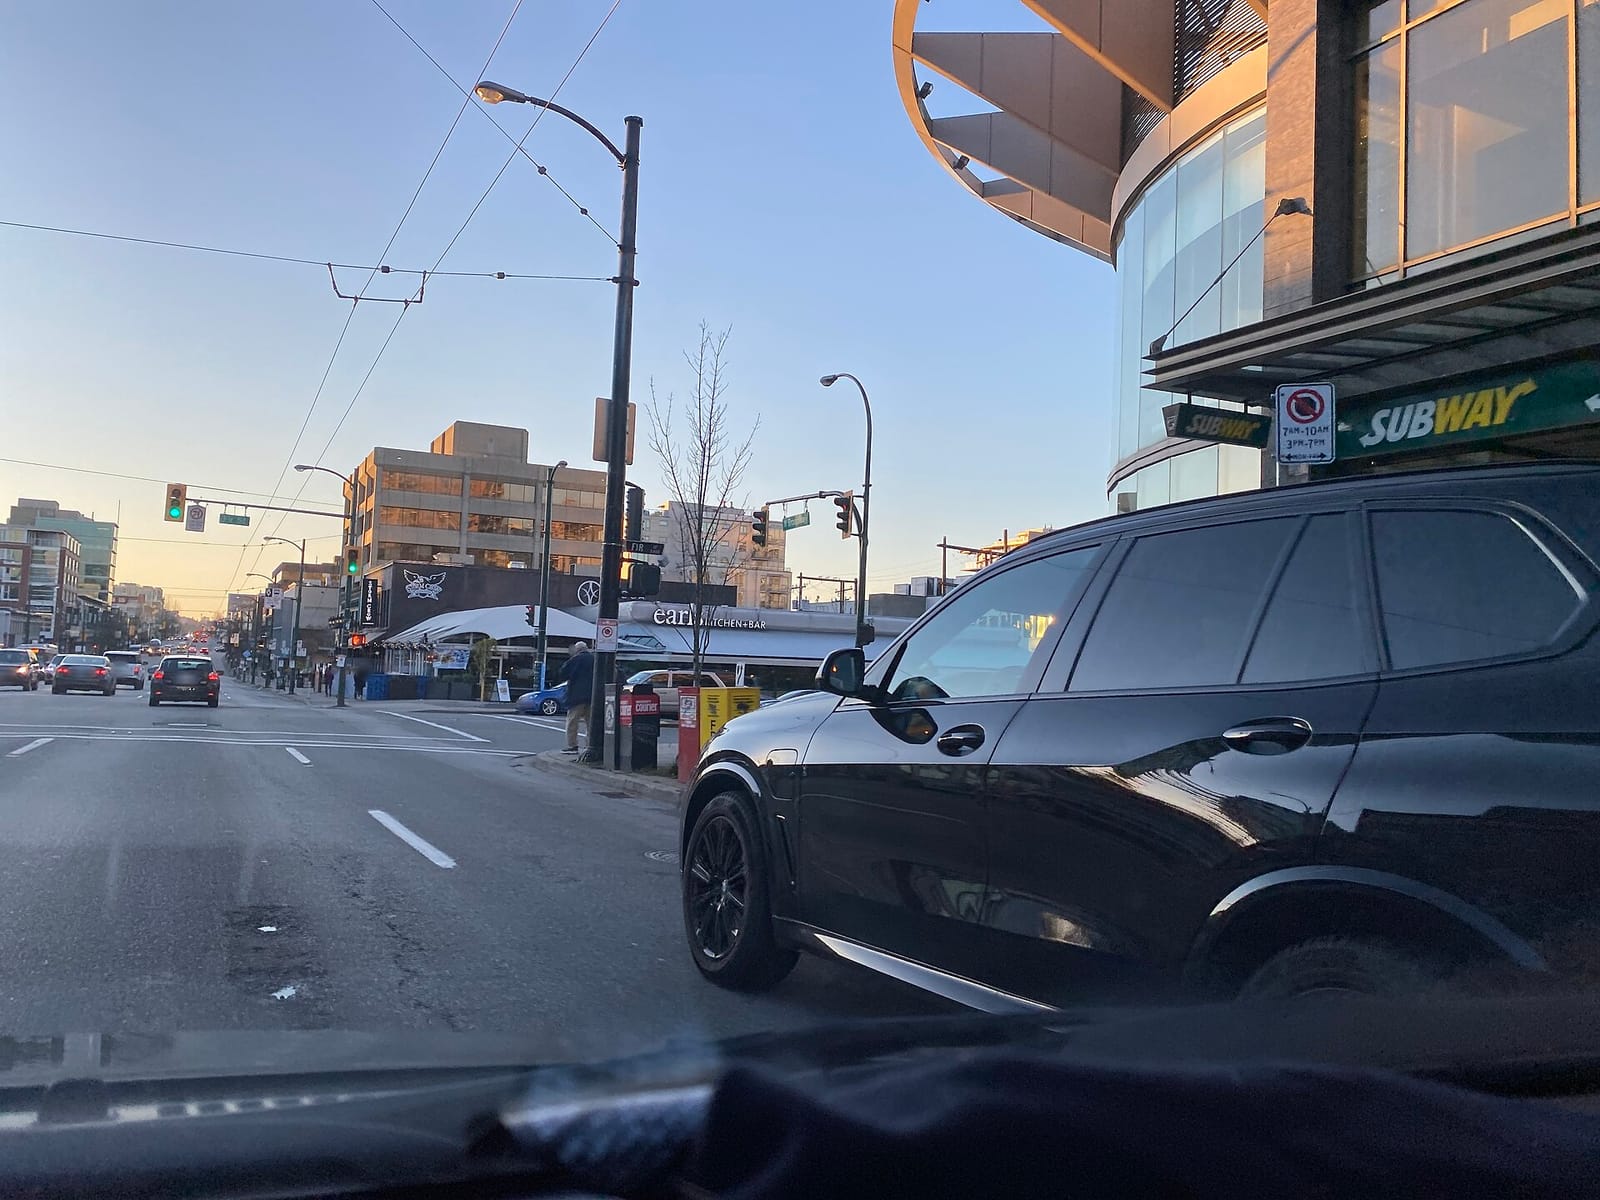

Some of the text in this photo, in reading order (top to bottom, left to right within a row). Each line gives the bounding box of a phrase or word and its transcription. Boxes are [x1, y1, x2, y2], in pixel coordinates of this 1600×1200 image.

[1359, 378, 1538, 448] SUBWAY
[1185, 415, 1260, 440] SUBWAY
[631, 543, 644, 552] FIR
